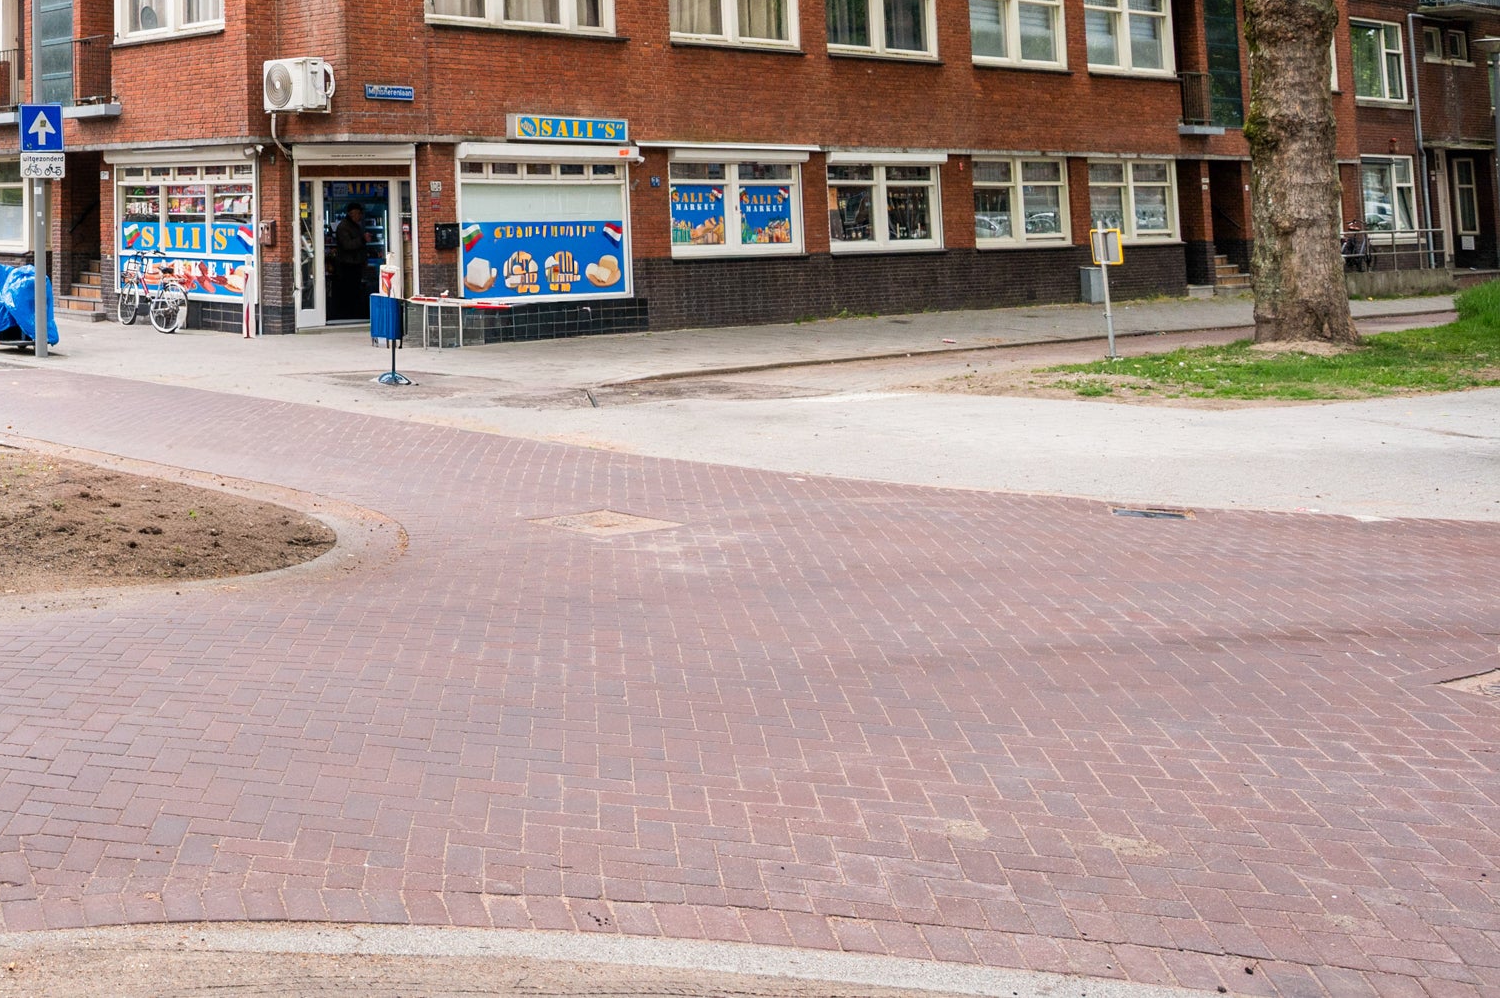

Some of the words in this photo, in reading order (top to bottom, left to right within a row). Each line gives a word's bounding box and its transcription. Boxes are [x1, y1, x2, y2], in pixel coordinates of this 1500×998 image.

[23, 155, 64, 163] uitgezonderd
[675, 203, 716, 211] MARKET
[745, 205, 783, 213] MARKET
